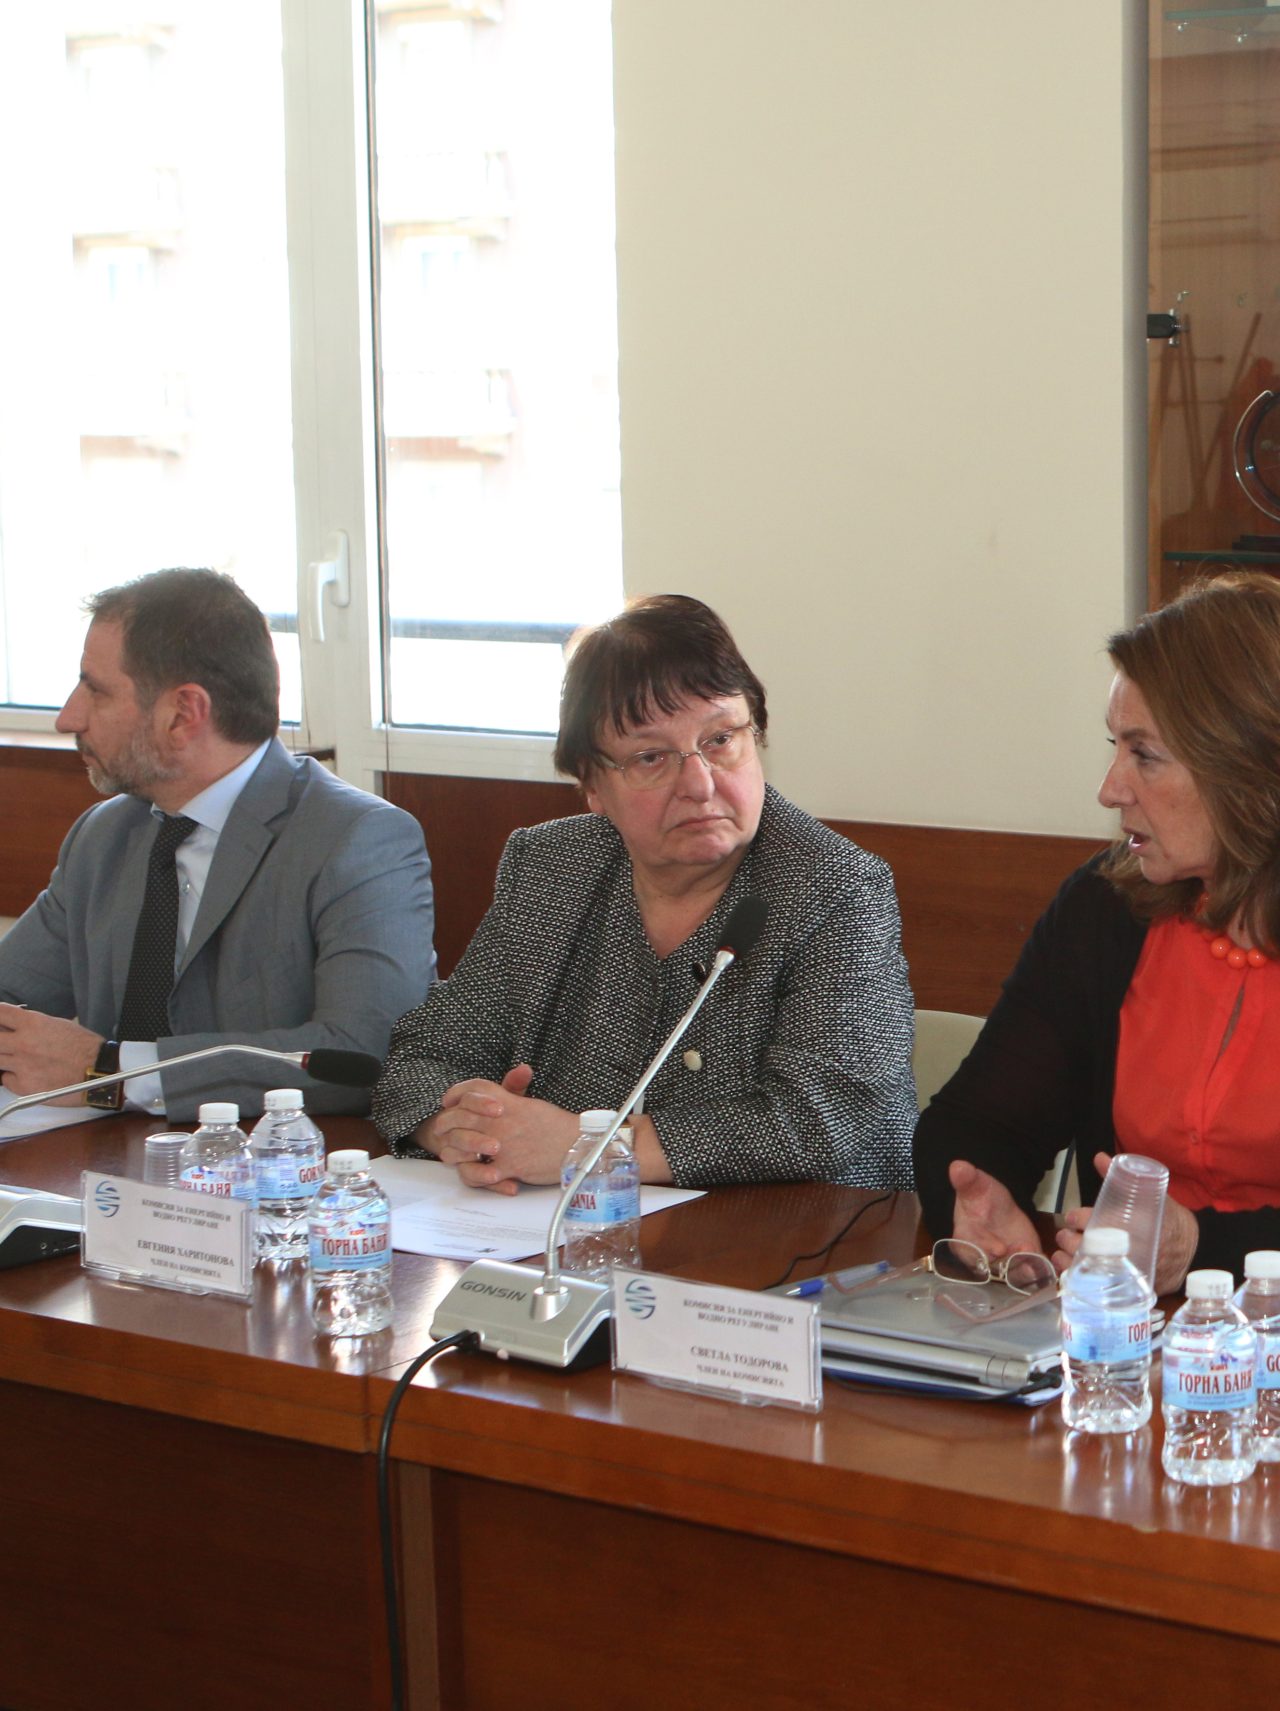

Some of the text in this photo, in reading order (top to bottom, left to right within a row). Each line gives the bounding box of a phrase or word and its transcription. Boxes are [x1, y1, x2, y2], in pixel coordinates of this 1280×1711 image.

[141, 1199, 175, 1212] КОМИСИЯ
[176, 1205, 184, 1213] ЗА
[137, 1239, 235, 1267] ЕВГЕНИЯ ХАРИТОНОВА
[322, 1238, 359, 1256] ГОРНА
[460, 1280, 527, 1302] GONSIN
[683, 1299, 725, 1313] КОМИСИЯ
[727, 1306, 737, 1315] ЗА
[690, 1345, 789, 1373] СВЕТЛА ТОДОРОВА
[1179, 1373, 1220, 1394] ГОРНА
